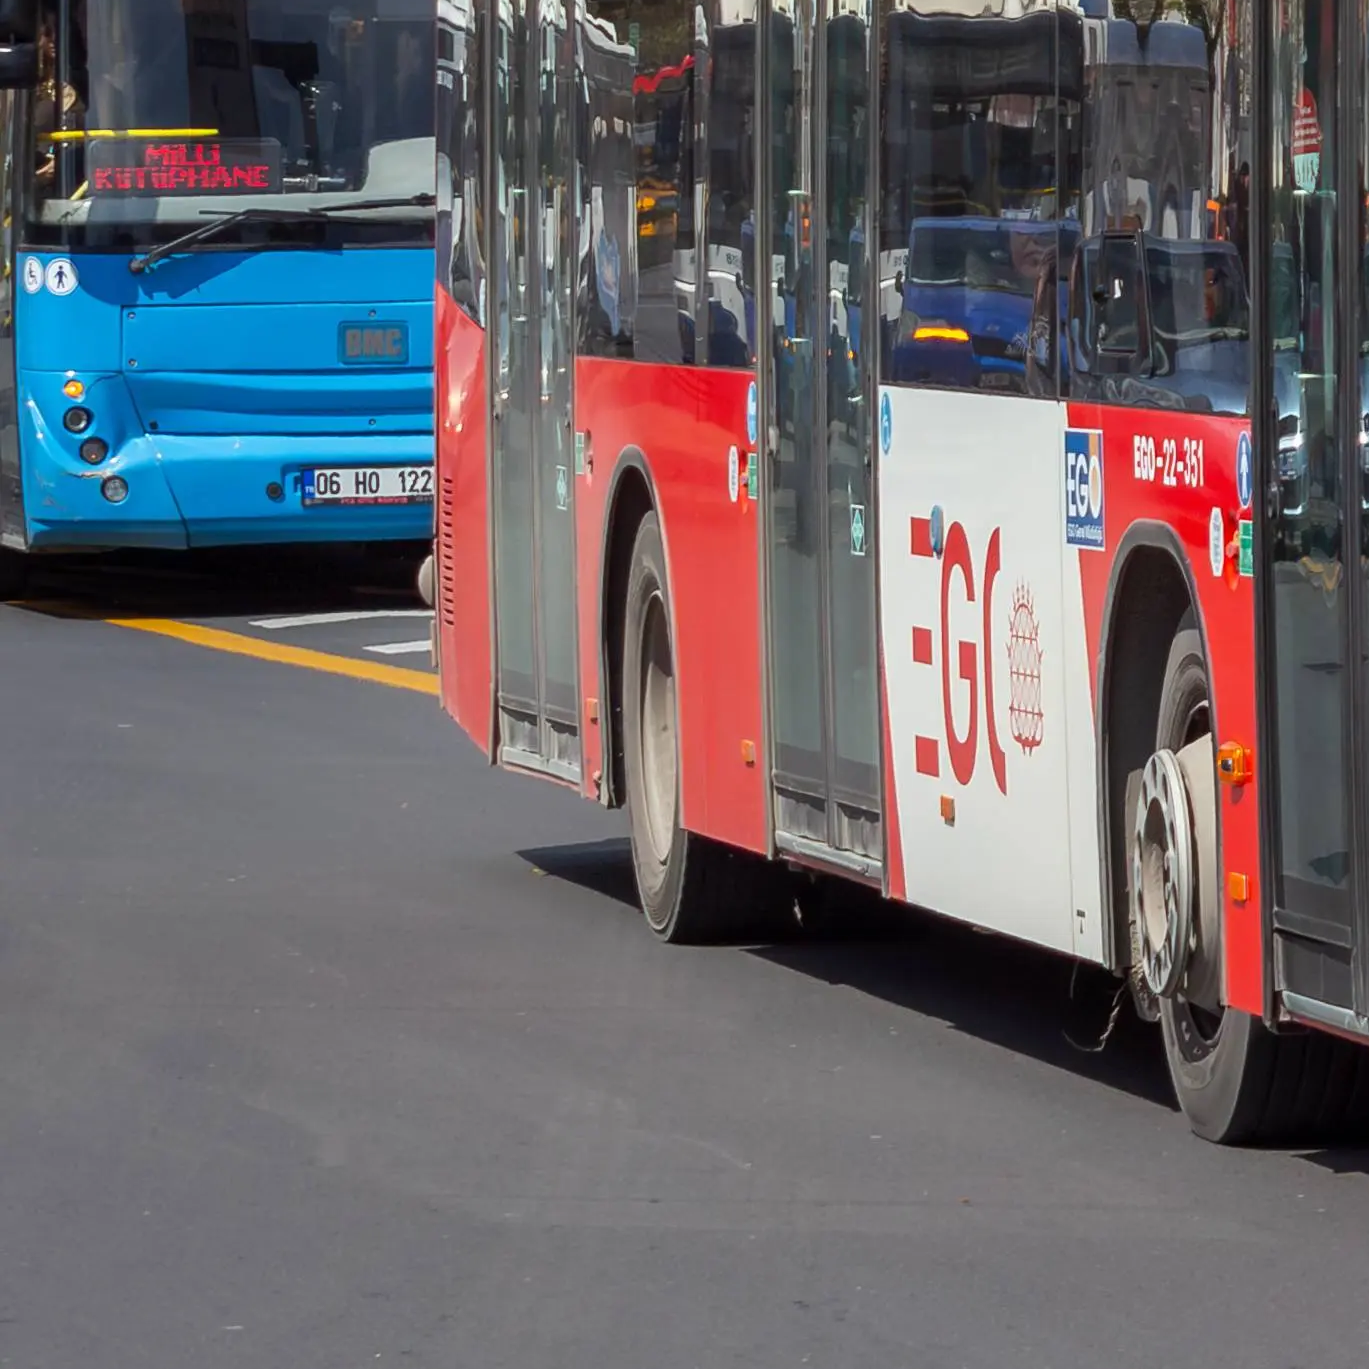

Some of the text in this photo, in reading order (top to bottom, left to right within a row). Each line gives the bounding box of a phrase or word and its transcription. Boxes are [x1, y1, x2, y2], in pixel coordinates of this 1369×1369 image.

[316, 472, 342, 495] 06
[398, 469, 433, 493] 122
[1066, 452, 1102, 519] EGO
